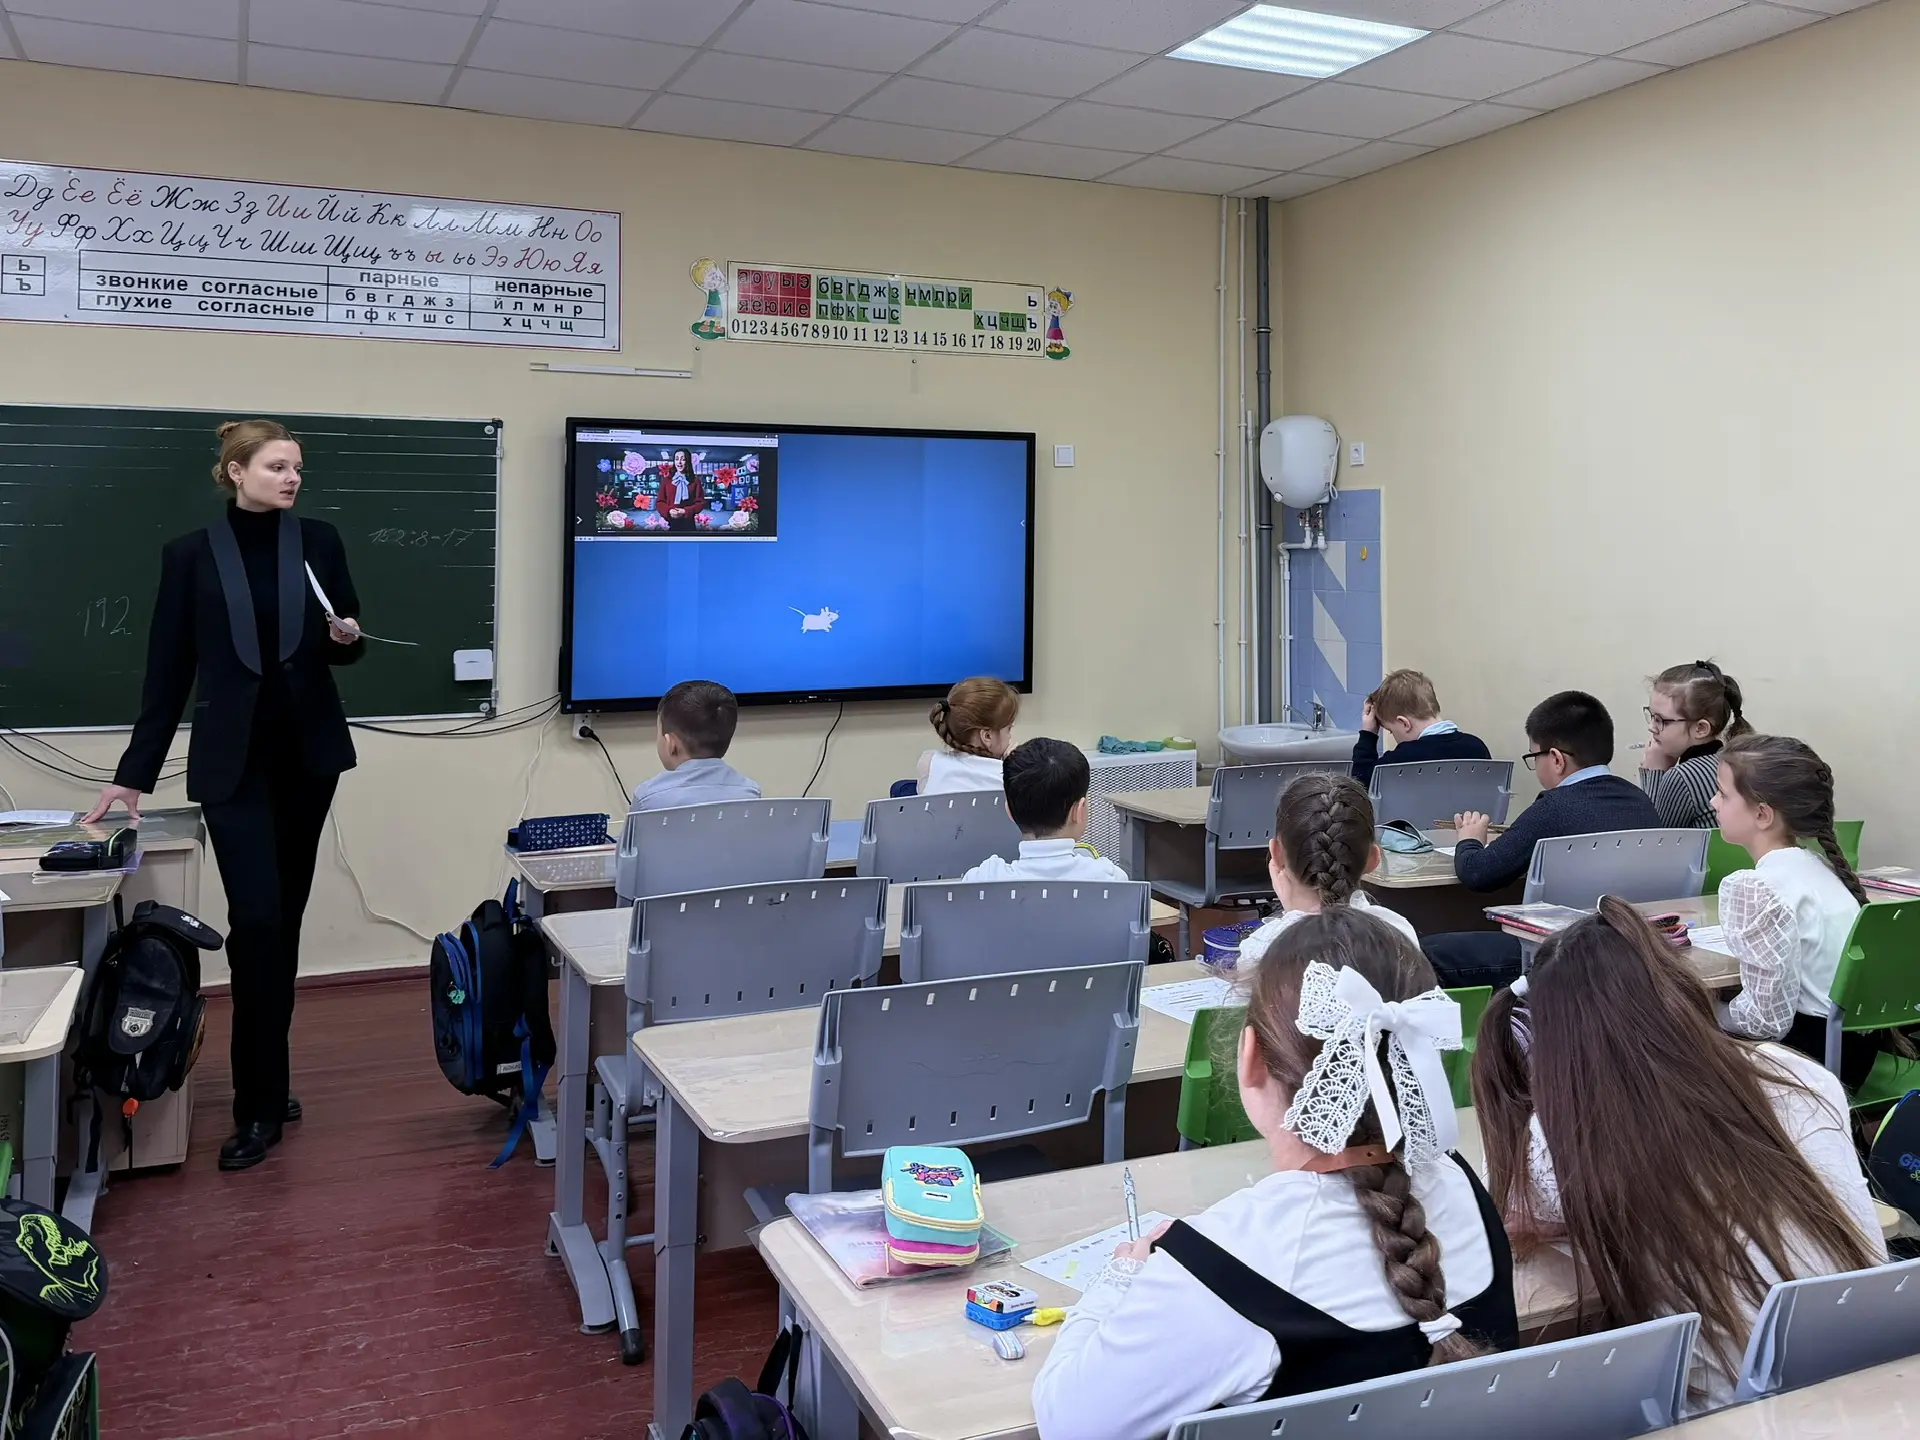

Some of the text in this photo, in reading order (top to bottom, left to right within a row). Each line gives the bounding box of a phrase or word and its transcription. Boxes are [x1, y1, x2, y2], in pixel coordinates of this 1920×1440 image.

[96, 274, 318, 299] звонкие согласные
[359, 269, 440, 288] парные
[494, 278, 594, 300] непарные
[96, 293, 315, 318] глухие согласные
[833, 326, 848, 341] 10
[853, 327, 867, 342] 11
[874, 328, 888, 343] 12
[894, 330, 908, 344] 13
[914, 331, 928, 345] 14
[933, 332, 947, 346] 15
[952, 333, 966, 347] 16
[971, 335, 985, 348] 17
[990, 336, 1004, 349] 18
[1009, 337, 1023, 350] 19
[1027, 338, 1041, 351] 20
